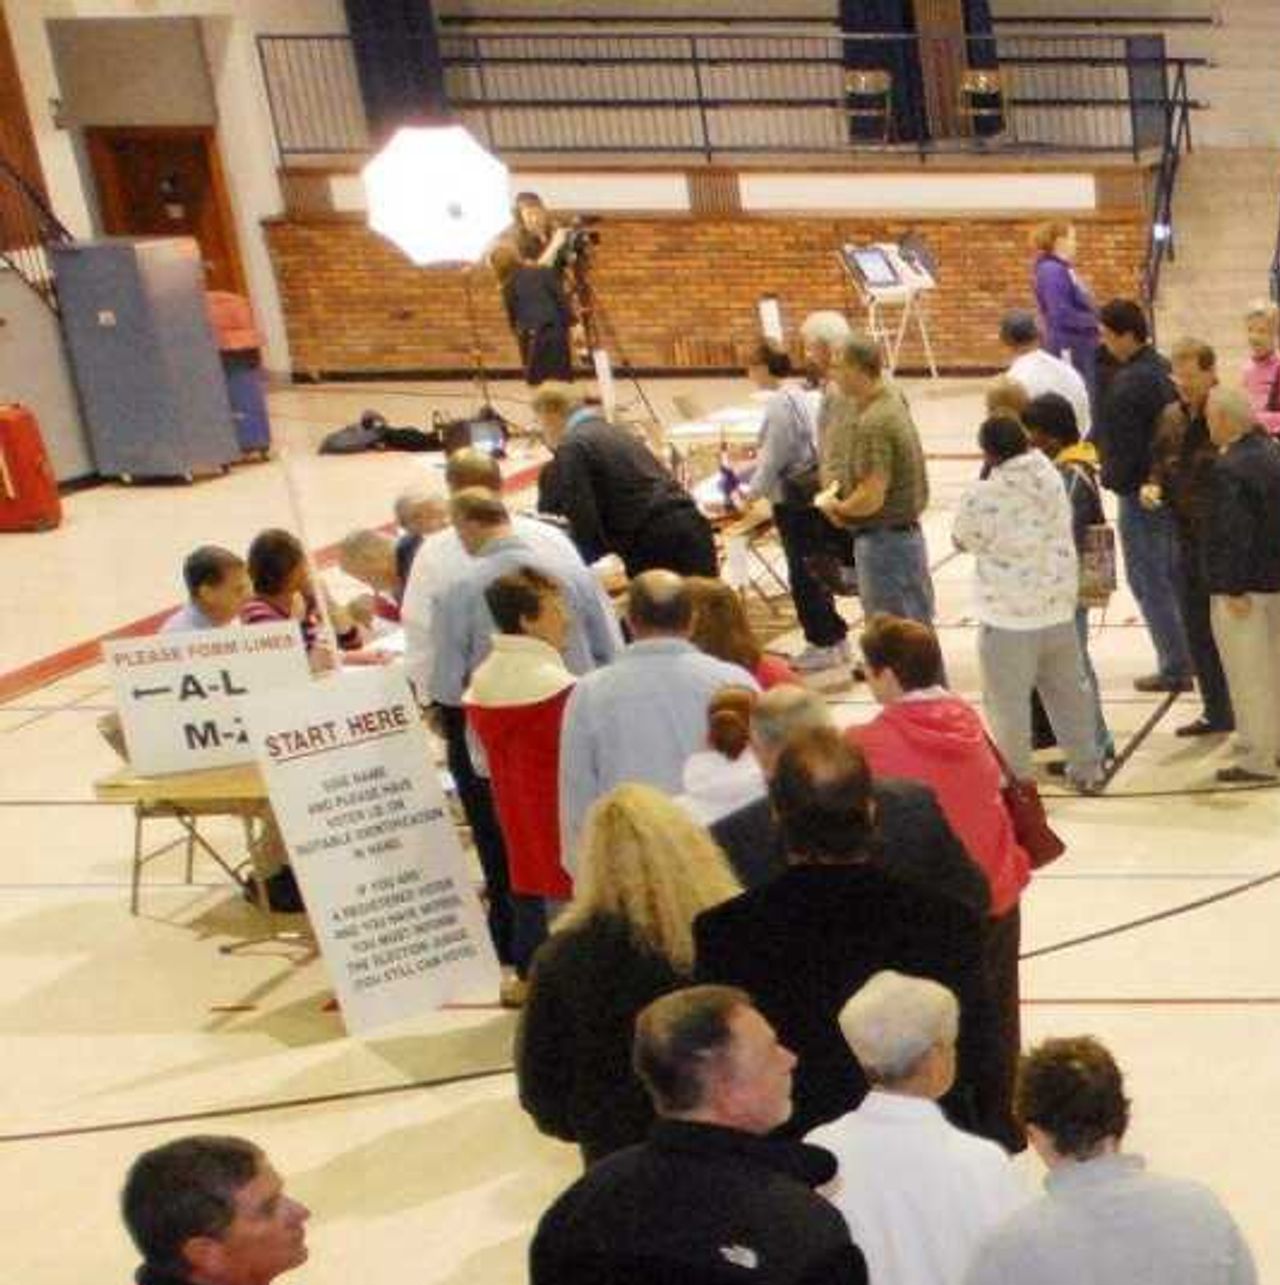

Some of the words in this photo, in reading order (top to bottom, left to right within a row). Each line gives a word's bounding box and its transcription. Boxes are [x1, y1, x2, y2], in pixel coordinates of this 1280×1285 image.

[114, 647, 181, 667] PLEASE
[187, 638, 238, 657] FORM
[243, 633, 293, 652] LINES
[178, 669, 249, 701] A-L
[265, 721, 336, 757] START
[346, 704, 409, 737] HERE
[334, 787, 378, 808] PLEASE
[371, 876, 396, 891] YOU
[377, 926, 410, 946] MUST
[347, 958, 370, 973] THE
[372, 941, 428, 966] ELECTION
[384, 963, 417, 983] STILL
